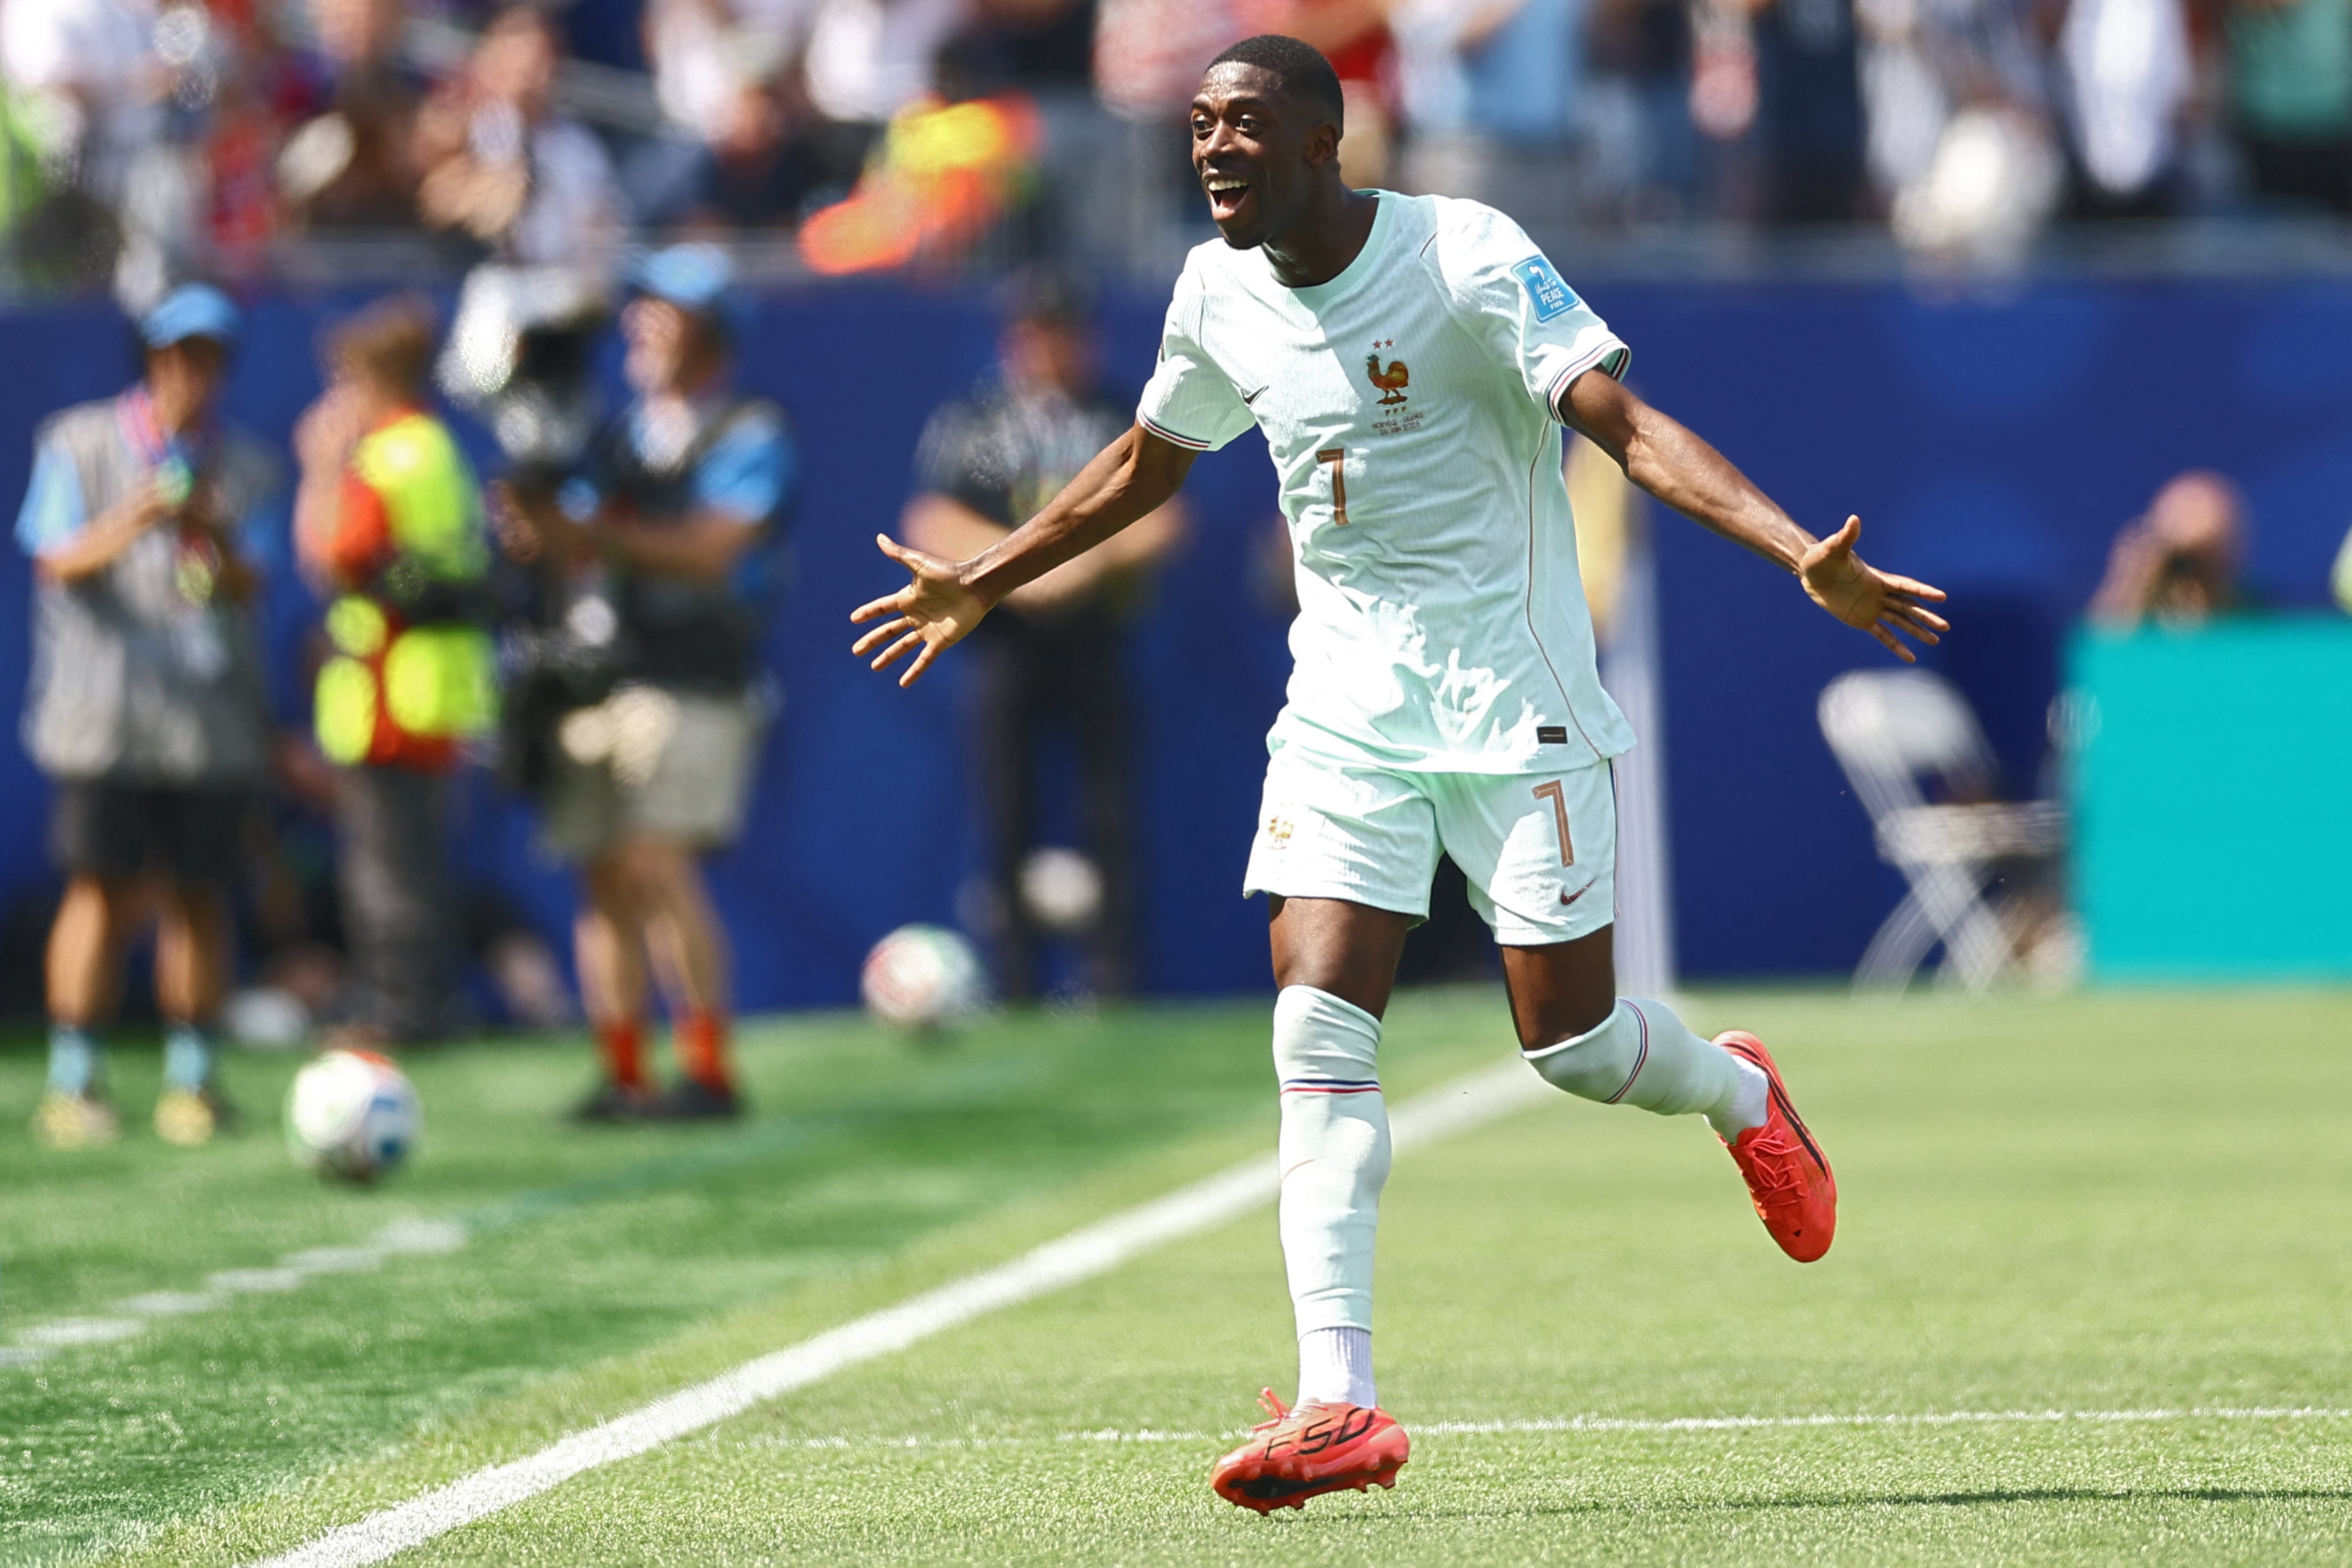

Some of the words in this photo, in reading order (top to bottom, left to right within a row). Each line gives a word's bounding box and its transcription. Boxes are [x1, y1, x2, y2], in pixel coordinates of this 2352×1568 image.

[1540, 287, 1564, 305] PEACE
[1549, 300, 1564, 310] FIFA
[1403, 412, 1423, 422] FRANCE
[1403, 421, 1421, 430] 2026
[1316, 448, 1350, 527] 7
[1532, 780, 1574, 868] 7
